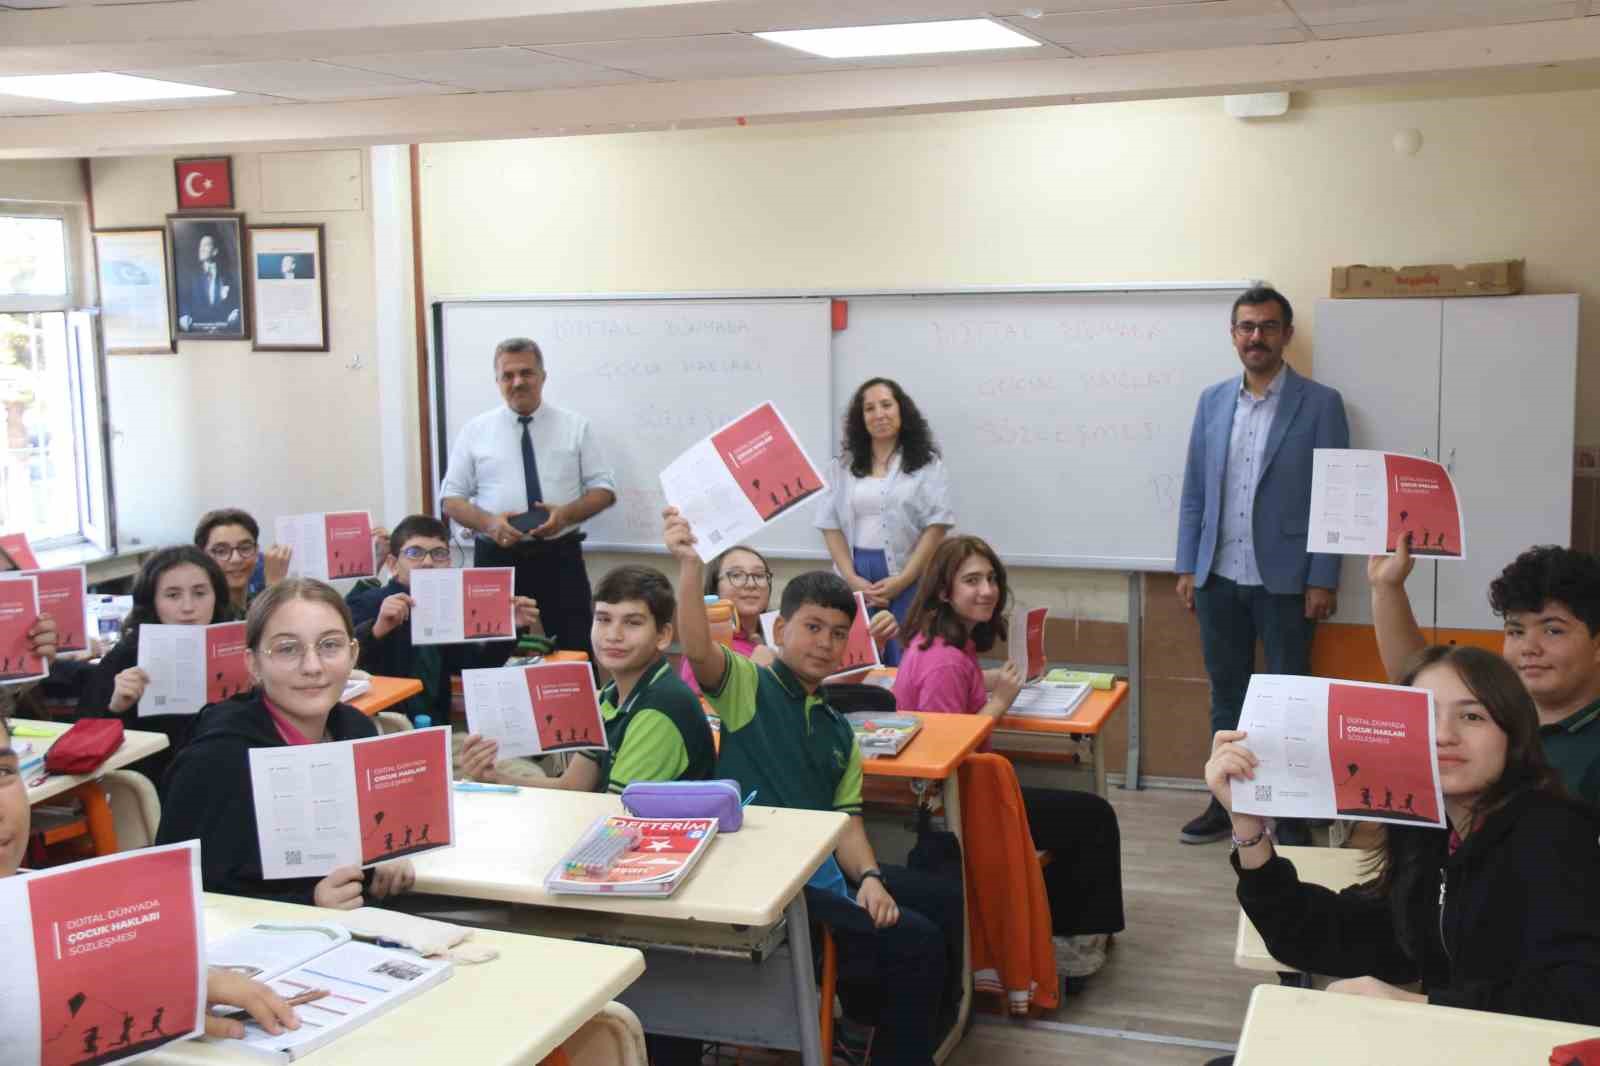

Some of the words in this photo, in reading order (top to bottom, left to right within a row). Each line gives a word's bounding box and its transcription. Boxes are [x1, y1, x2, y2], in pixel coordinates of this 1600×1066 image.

[107, 899, 160, 920] DÜNYADA
[67, 925, 110, 945] ÇOCUK
[111, 911, 160, 932] HAKLARI
